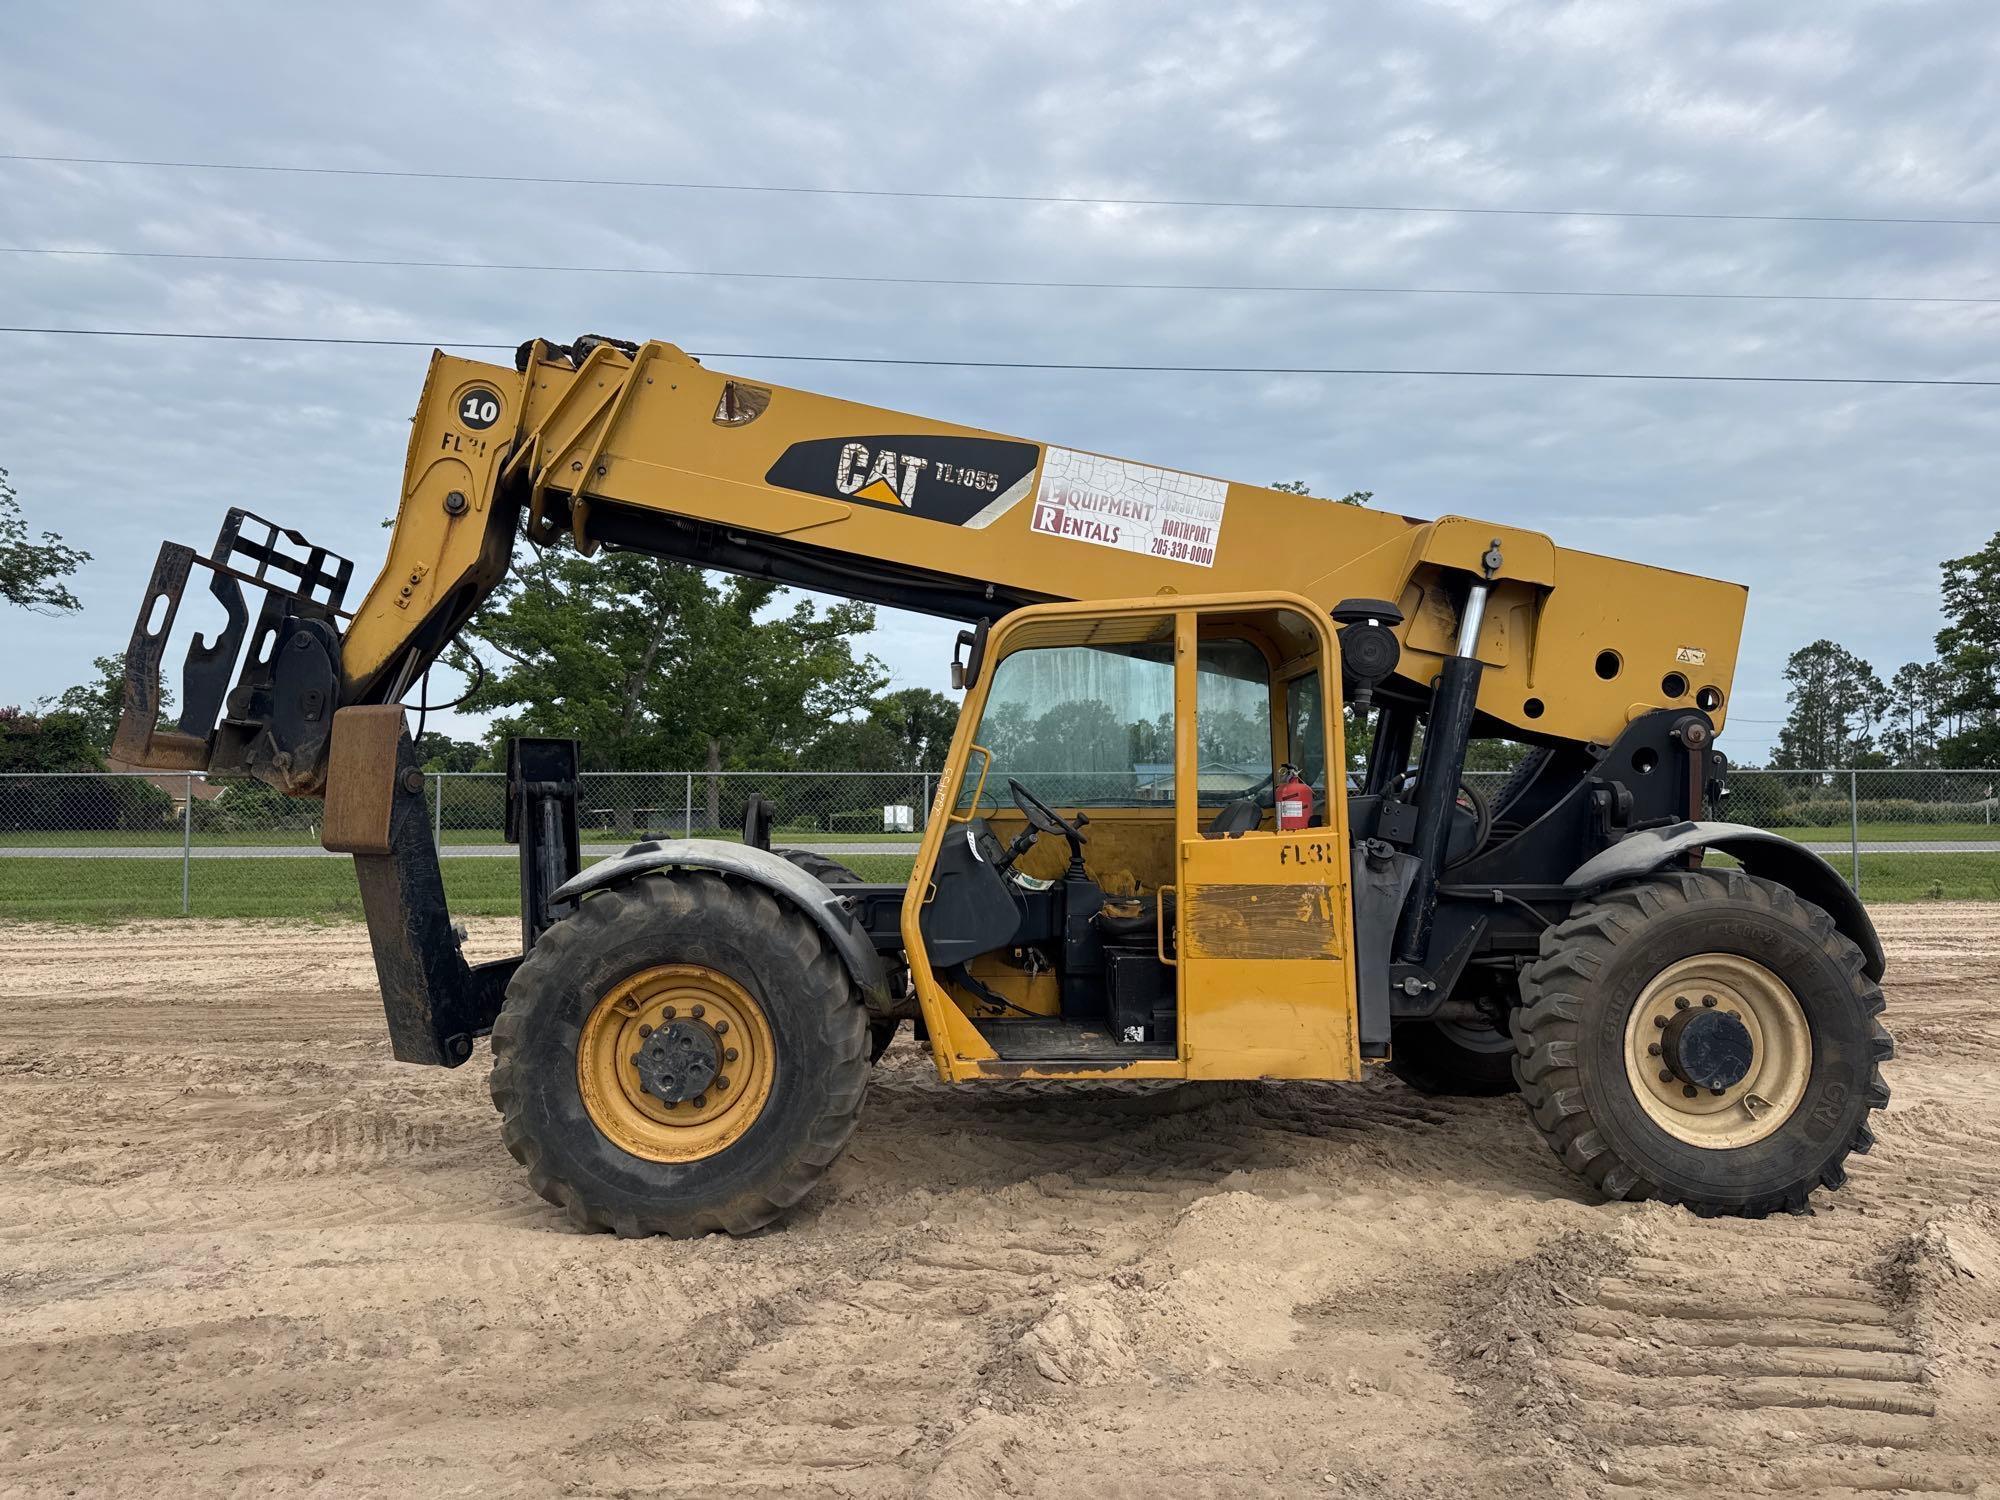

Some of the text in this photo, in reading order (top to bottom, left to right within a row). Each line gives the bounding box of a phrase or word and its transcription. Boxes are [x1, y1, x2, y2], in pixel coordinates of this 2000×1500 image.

[463, 398, 498, 422] 10
[835, 443, 928, 508] CAT
[935, 461, 999, 492] TL1055
[1041, 478, 1154, 522] EQUIPMENT
[1036, 506, 1121, 544] RENTALS
[1161, 519, 1212, 544] NORTHPORT
[1151, 537, 1213, 565] 205-330-0000
